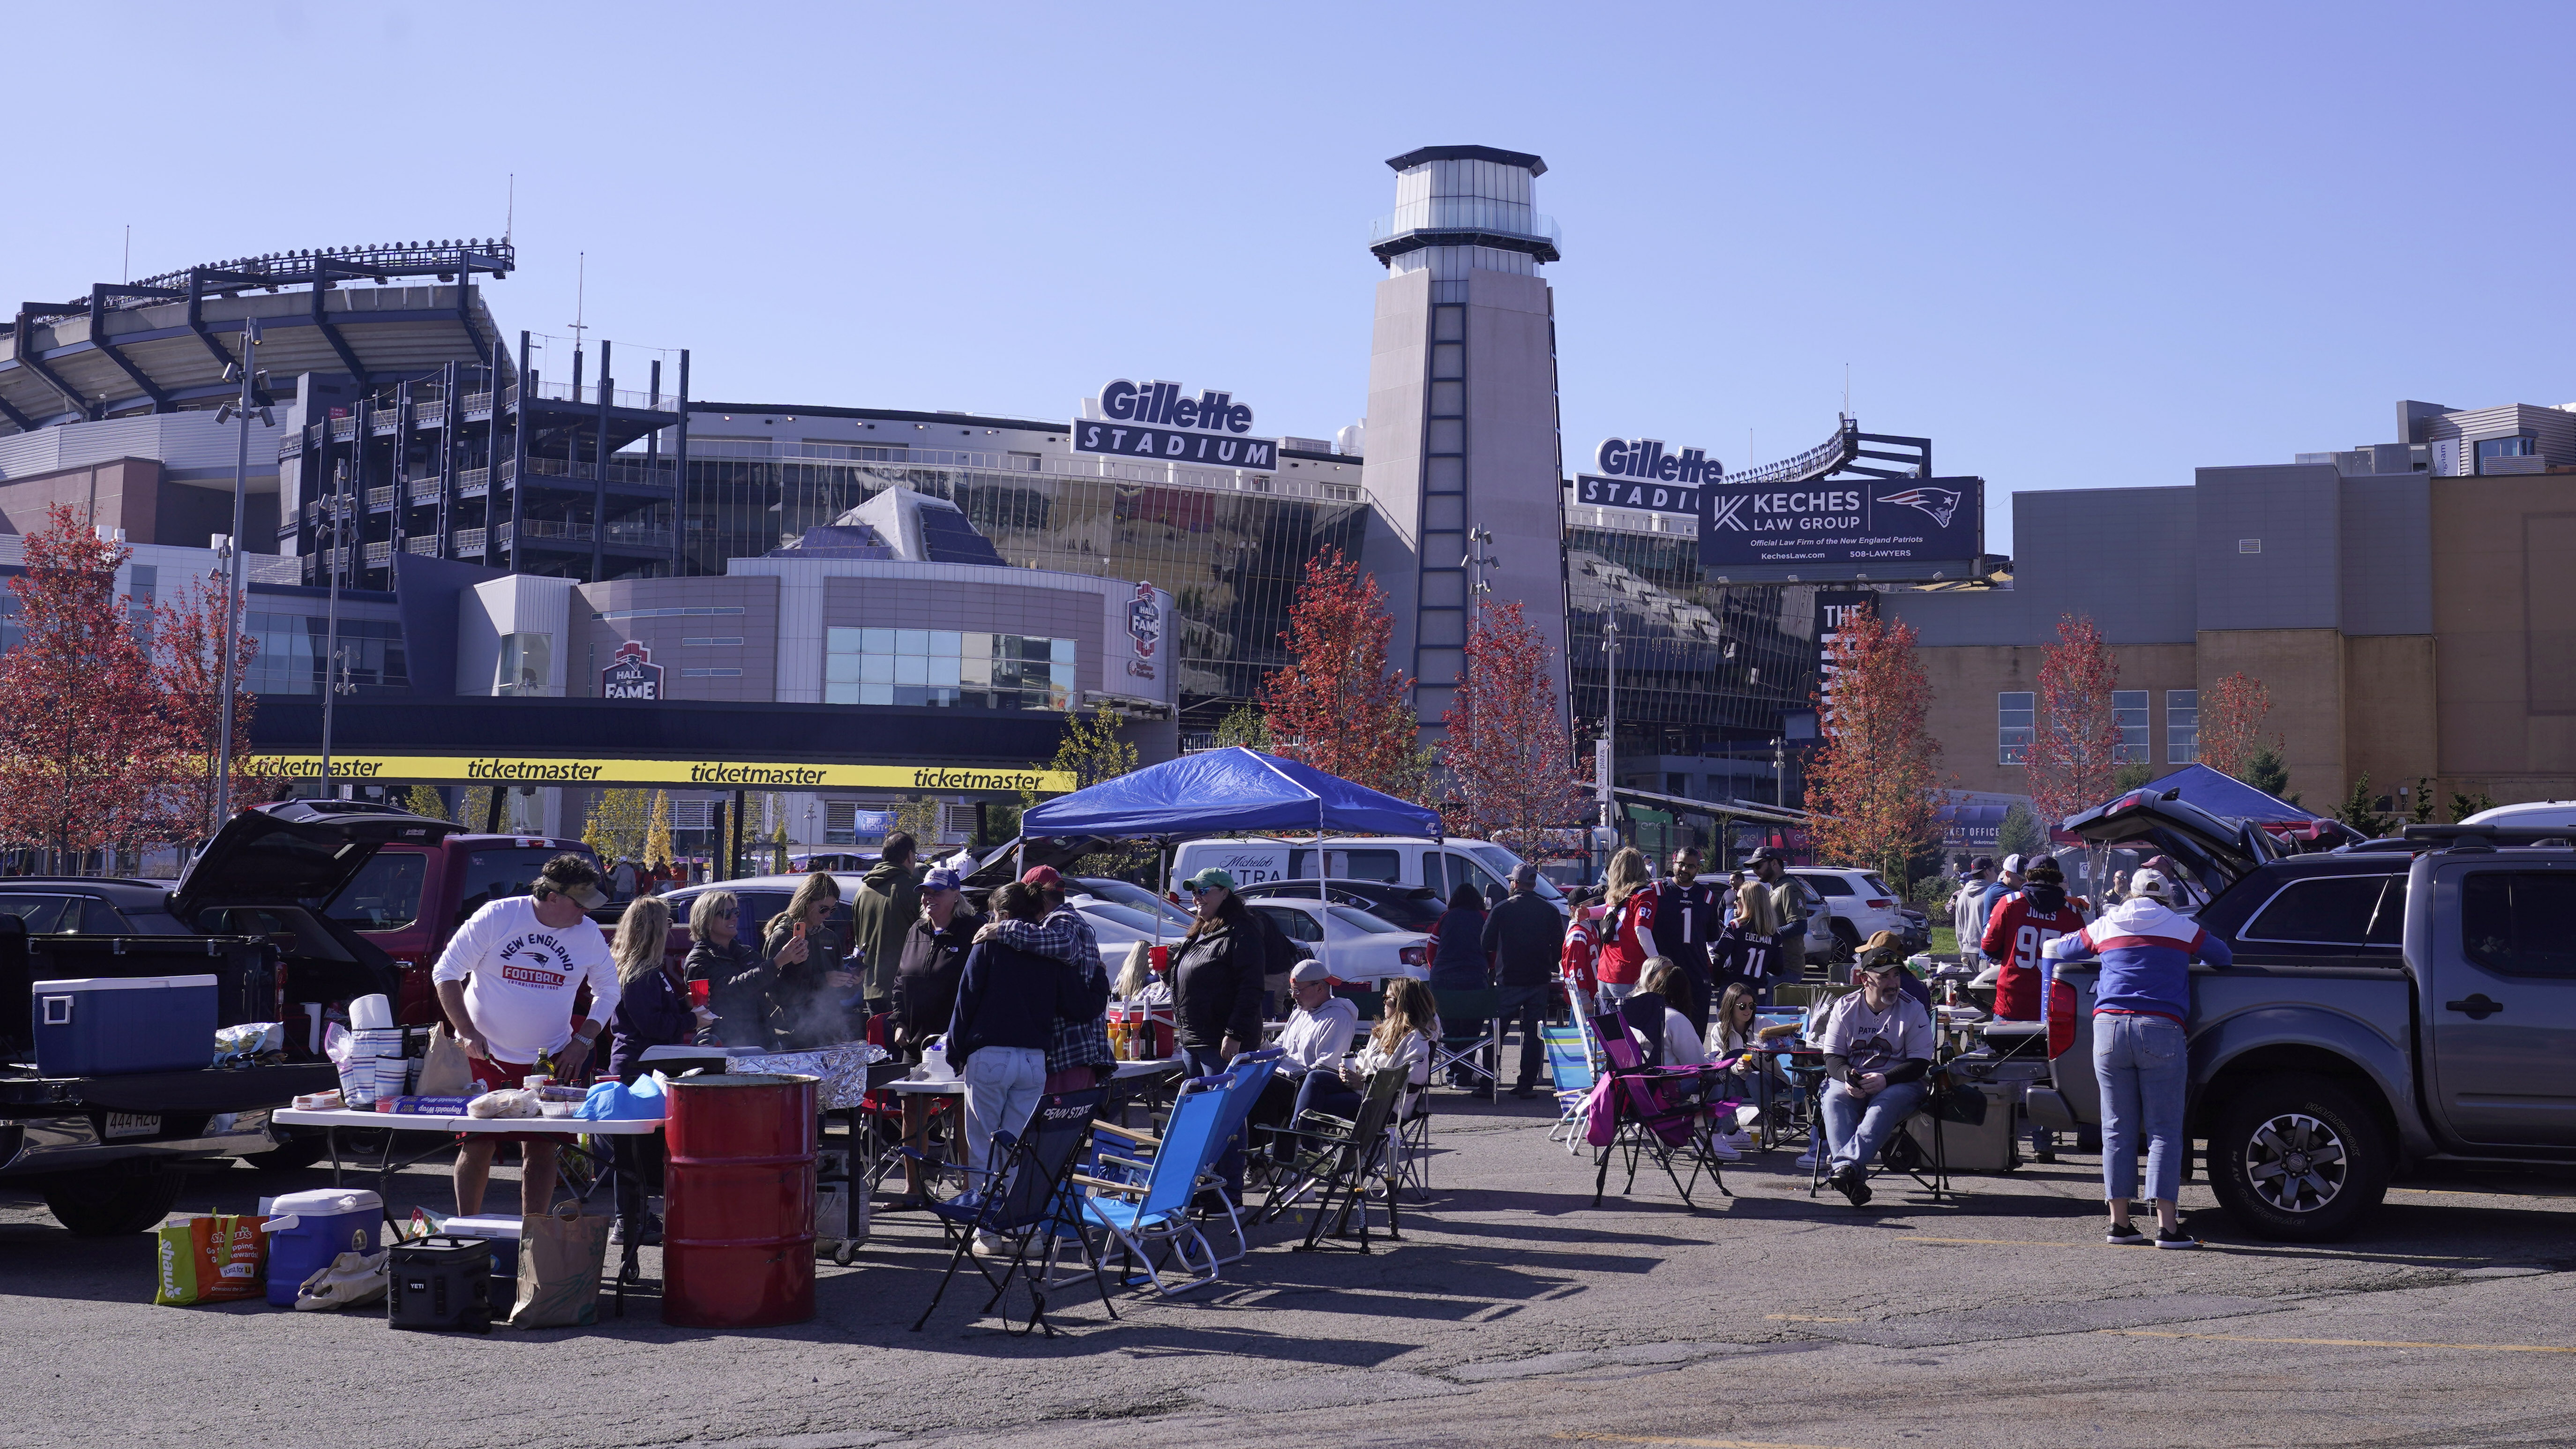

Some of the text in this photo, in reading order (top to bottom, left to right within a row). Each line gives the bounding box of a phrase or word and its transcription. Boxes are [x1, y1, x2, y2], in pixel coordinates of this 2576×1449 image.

[1103, 381, 1252, 433] Gillette
[1084, 426, 1269, 465] STADIUM
[1600, 440, 1723, 485] Gillette
[1754, 491, 1860, 513] KECHES
[1754, 516, 1860, 531] LAW GROUP
[1859, 536, 1891, 545] England
[1761, 549, 1911, 560] KechesLaw.com 508-LAWYERS
[1139, 606, 1155, 616] HALL
[1133, 615, 1159, 633] FAME
[616, 671, 644, 680] HALL
[605, 681, 656, 700] FAME
[468, 759, 603, 780] ticketmaster
[691, 763, 826, 784] ticketmaster
[914, 768, 1044, 790] ticketmaster
[1969, 828, 2000, 836] OFFICE
[1220, 855, 1275, 868] Michelob
[1639, 907, 1652, 919] 87
[1681, 908, 1692, 943] 1
[1745, 932, 1772, 945] EDELMAN
[500, 934, 574, 971] NEW ENGLAND
[1743, 947, 1766, 978] 11
[505, 967, 564, 985] FOOTBALL
[1569, 968, 1584, 981] 24
[508, 979, 545, 989] ESTABLISHED
[419, 1105, 435, 1113] Wrap
[1042, 1108, 1070, 1120] PENN
[110, 1113, 132, 1128] 444
[224, 1267, 236, 1276] just
